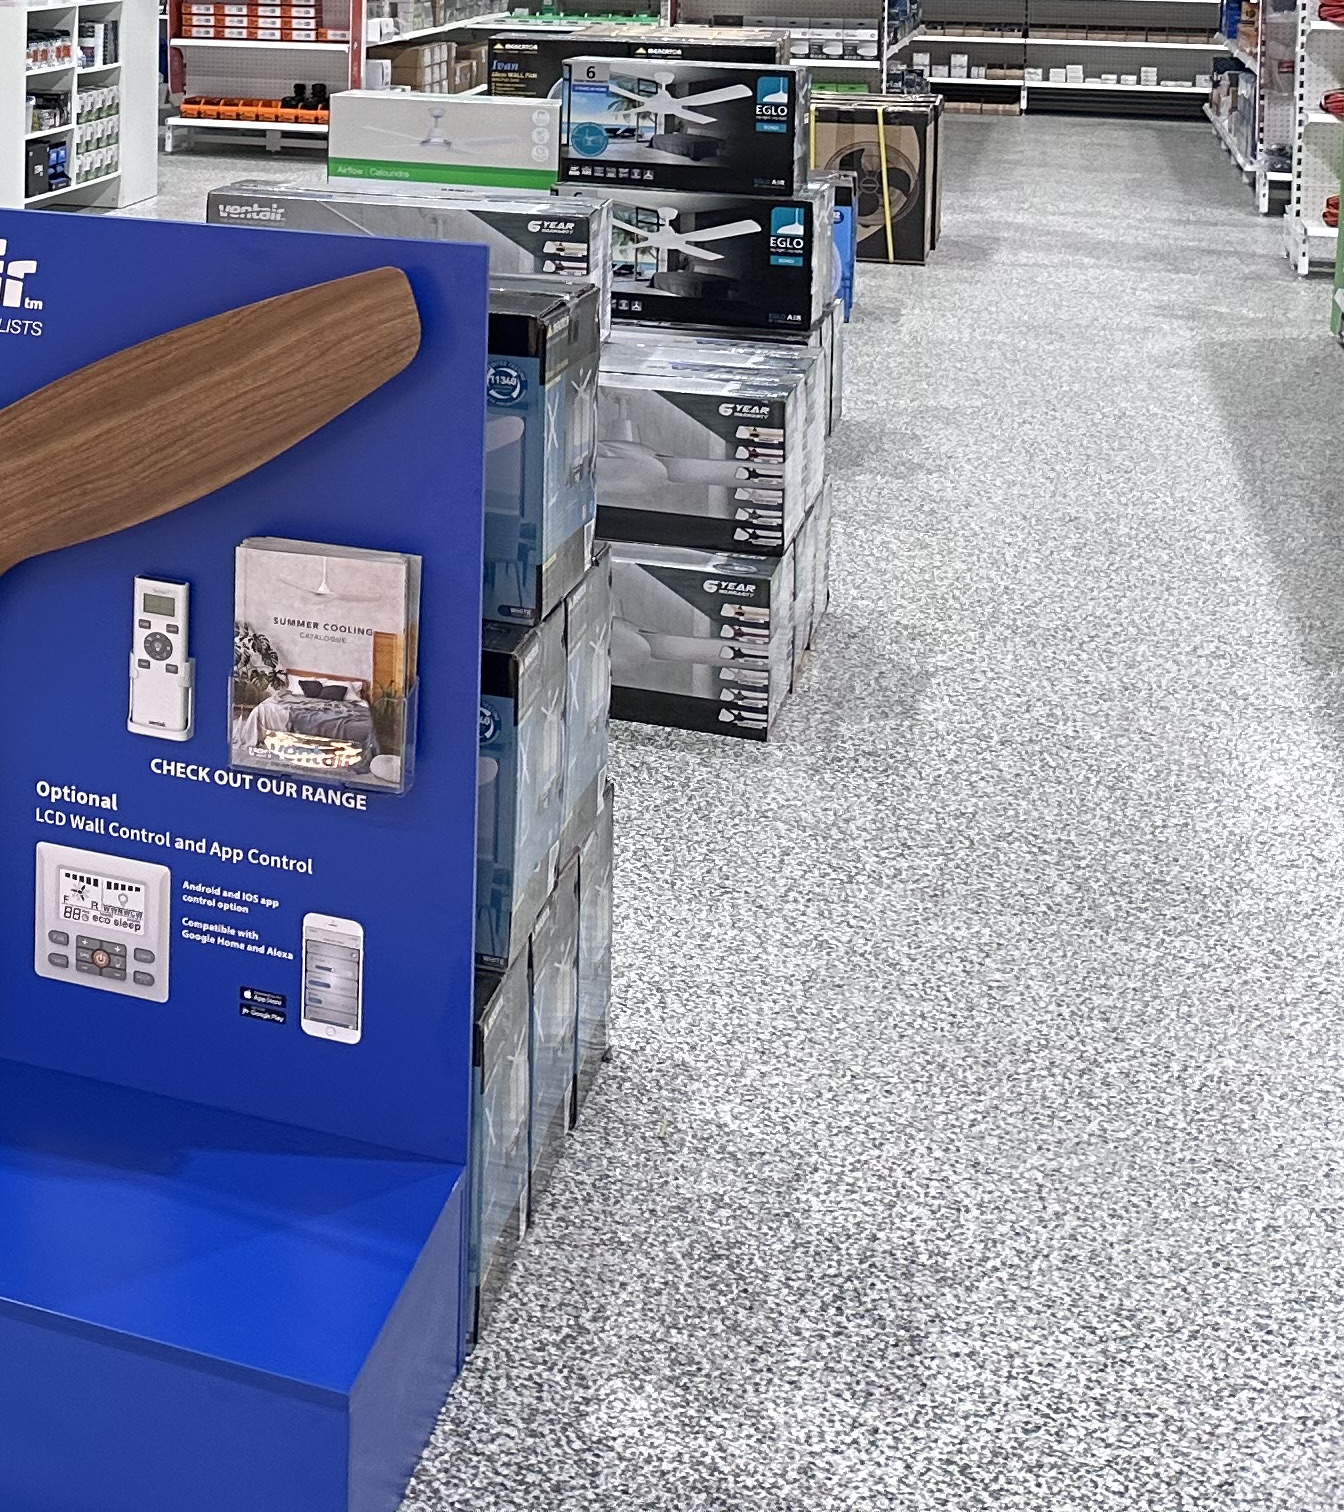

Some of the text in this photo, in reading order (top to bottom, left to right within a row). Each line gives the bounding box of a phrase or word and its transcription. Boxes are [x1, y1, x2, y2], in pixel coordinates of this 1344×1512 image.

[492, 59, 519, 71] Ivan
[586, 65, 596, 80] 6
[755, 104, 788, 117] EGLO
[336, 165, 363, 176] Airflow
[771, 178, 786, 186] AIR
[218, 203, 286, 222] ventair
[527, 220, 574, 234] 6 YEAR
[769, 237, 804, 250] EGLO
[787, 313, 802, 322] AIR
[718, 403, 771, 417] 6 YEAR
[703, 579, 756, 595] 6 YEAR
[273, 616, 373, 637] SUMMER COOLING
[299, 631, 347, 644] CATALOGUE
[150, 758, 367, 811] CHECK OUT OUR RANGE
[36, 780, 118, 812] Optional
[36, 807, 313, 875] LCD Wall Control and App Control
[182, 880, 220, 896] Android
[222, 889, 241, 901] and
[260, 896, 280, 909] app
[182, 894, 249, 914] control option
[92, 914, 141, 933] eco sleep
[182, 917, 259, 941] Compatible with
[182, 929, 294, 960] Google Home and Alexa
